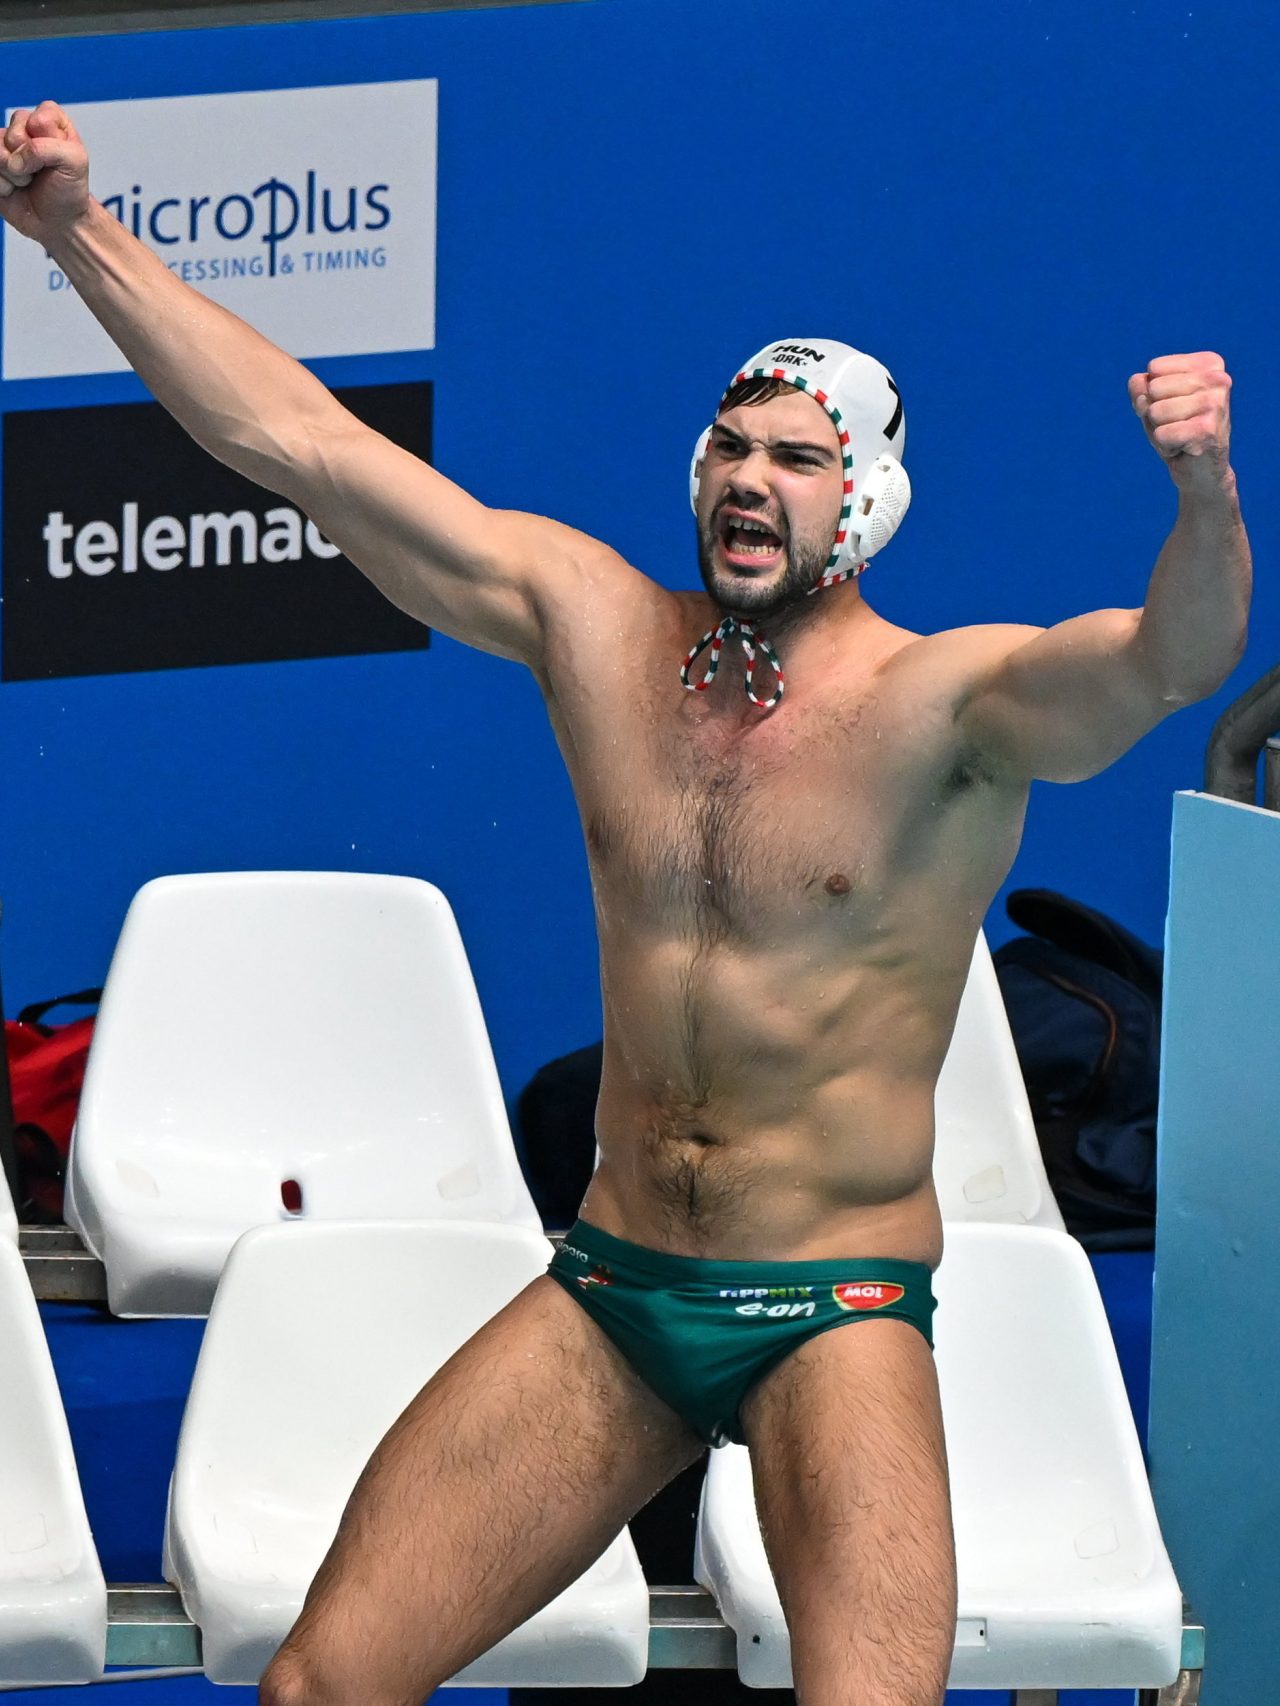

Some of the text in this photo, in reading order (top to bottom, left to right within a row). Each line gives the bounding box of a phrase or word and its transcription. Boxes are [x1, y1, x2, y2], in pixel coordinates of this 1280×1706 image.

[302, 247, 387, 272] TIMING
[773, 345, 825, 362] HUN
[844, 1286, 884, 1299] MOL
